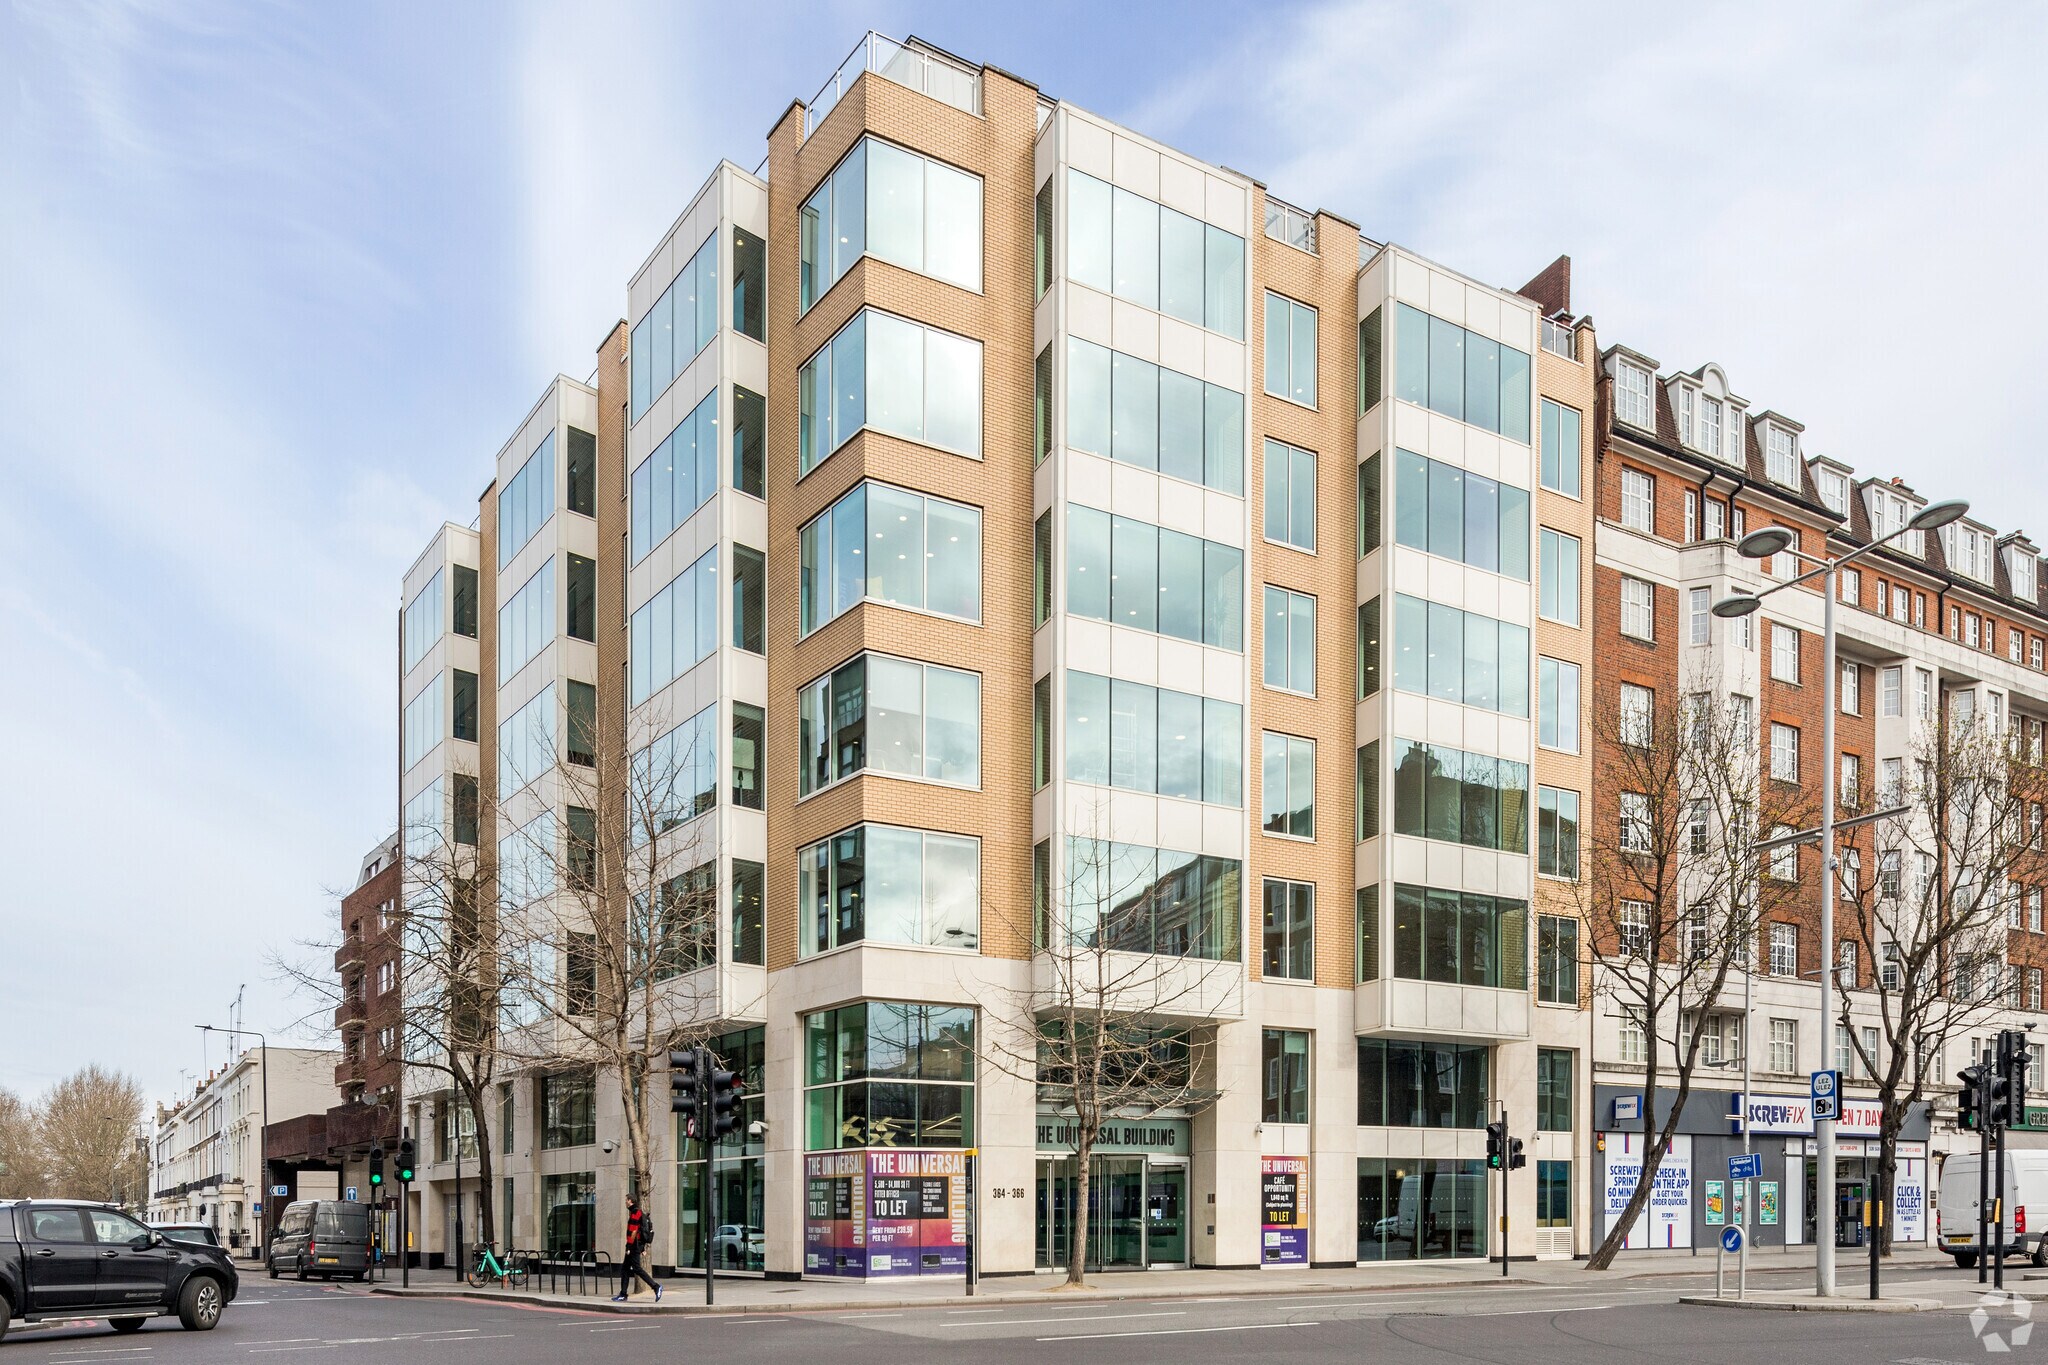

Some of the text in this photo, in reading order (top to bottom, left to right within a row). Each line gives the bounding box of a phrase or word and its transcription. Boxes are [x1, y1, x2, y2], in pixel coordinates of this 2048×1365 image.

[1818, 1077, 1829, 1085] LEZ
[1748, 1104, 1806, 1127] SCREWFIX
[1835, 1108, 1882, 1127] EN 7 DAY
[2029, 1112, 2048, 1126] GRE
[1036, 1125, 1053, 1144] HE
[1124, 1127, 1175, 1146] BUILDING
[808, 1154, 863, 1176] THE UNIVERSAL
[871, 1153, 966, 1174] THE UNIVERSAL
[1272, 1160, 1306, 1172] UNIVERSAL
[1609, 1165, 1643, 1175] SCREWFIX
[1655, 1168, 1686, 1178] CHECK-IN
[1273, 1175, 1286, 1184] CAFÉ
[1614, 1176, 1637, 1187] SPRINT
[1652, 1179, 1690, 1189] ON THE APP
[992, 1188, 1005, 1198] 364
[1012, 1188, 1024, 1198] 366
[1263, 1184, 1295, 1192] OPPORTUNITY
[1298, 1173, 1307, 1213] BUILDING
[1608, 1187, 1616, 1197] 60
[1897, 1186, 1921, 1197] CLICK &
[1671, 1190, 1683, 1198] YOUR
[874, 1200, 907, 1216] TO LET
[1652, 1198, 1688, 1207] ORDER QUICKER
[1896, 1197, 1921, 1208] COLLECT
[809, 1201, 828, 1216] TO LET
[853, 1176, 863, 1244] BUILDING
[952, 1176, 966, 1243] BUILDING
[1270, 1211, 1289, 1222] TO LET
[884, 1226, 896, 1234] FROM
